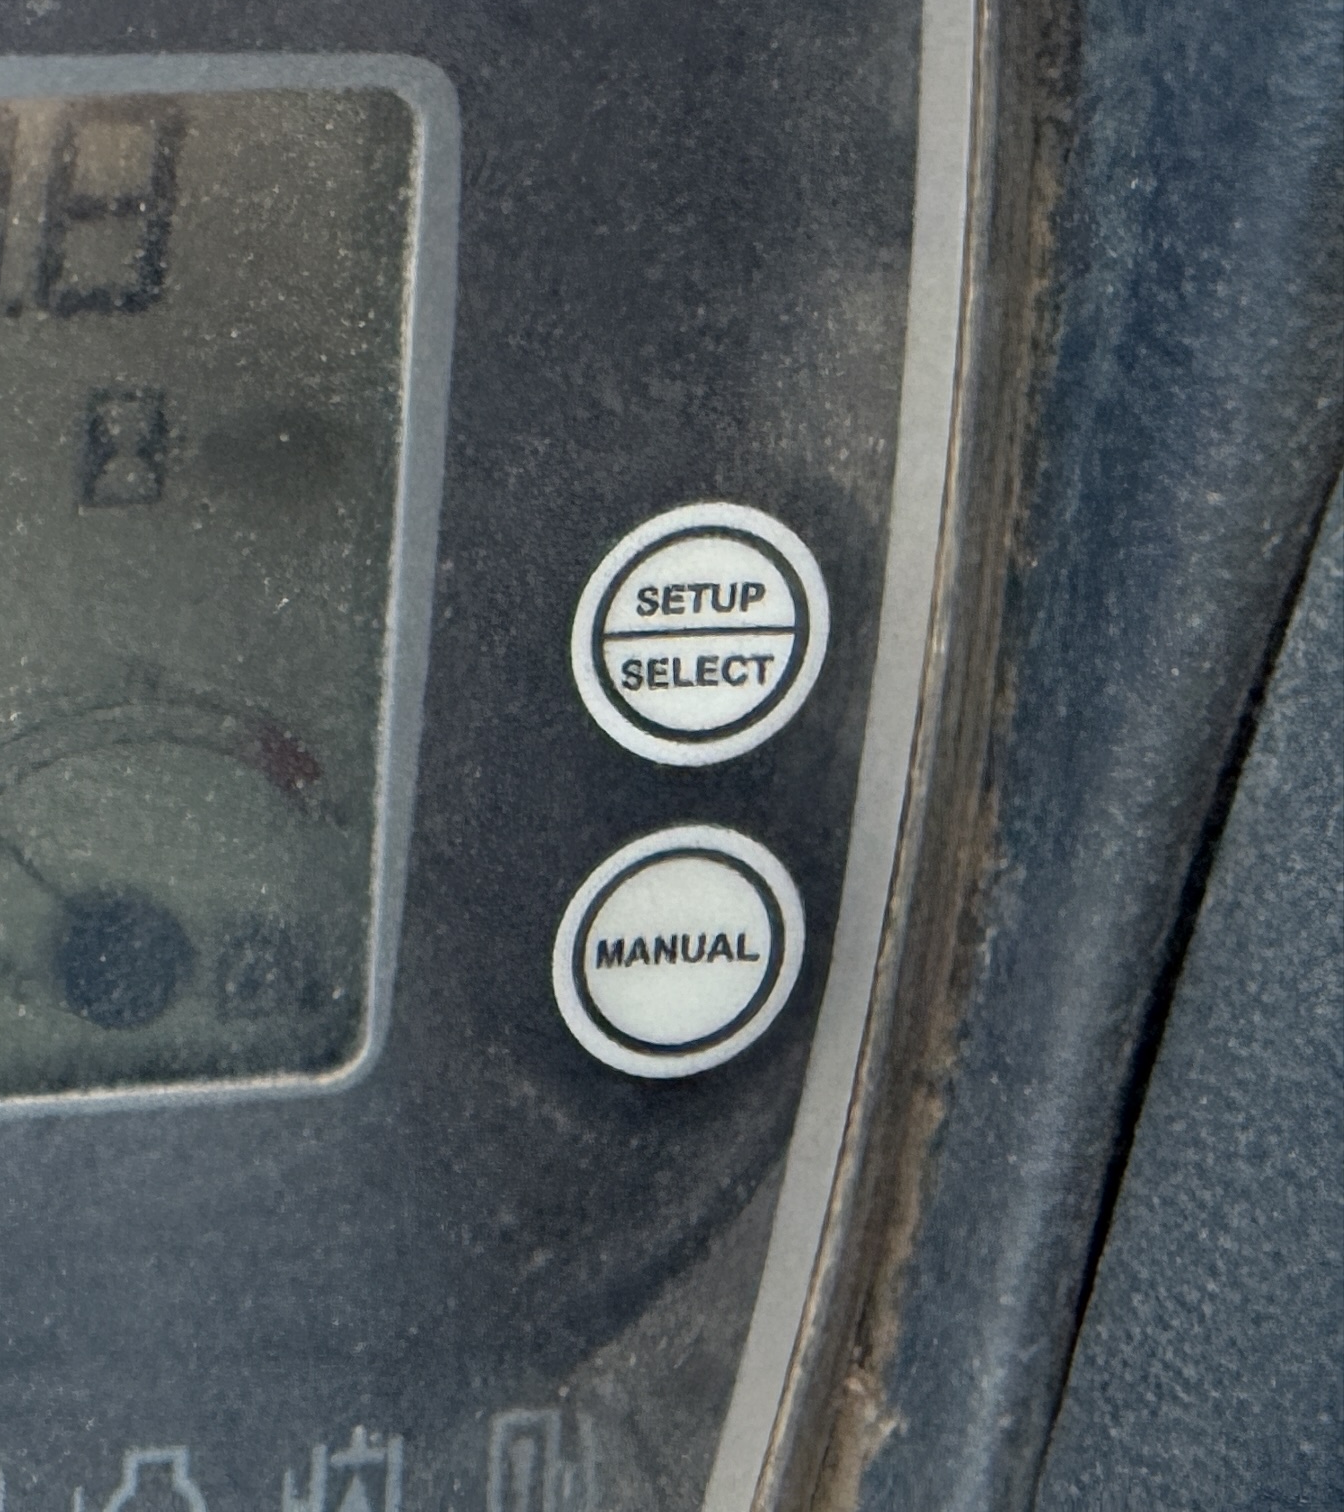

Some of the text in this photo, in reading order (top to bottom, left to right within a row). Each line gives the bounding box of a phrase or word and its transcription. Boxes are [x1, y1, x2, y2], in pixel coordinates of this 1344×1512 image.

[635, 580, 767, 617] SETUP
[620, 653, 775, 691] SELECT
[594, 932, 760, 970] MANUAL
